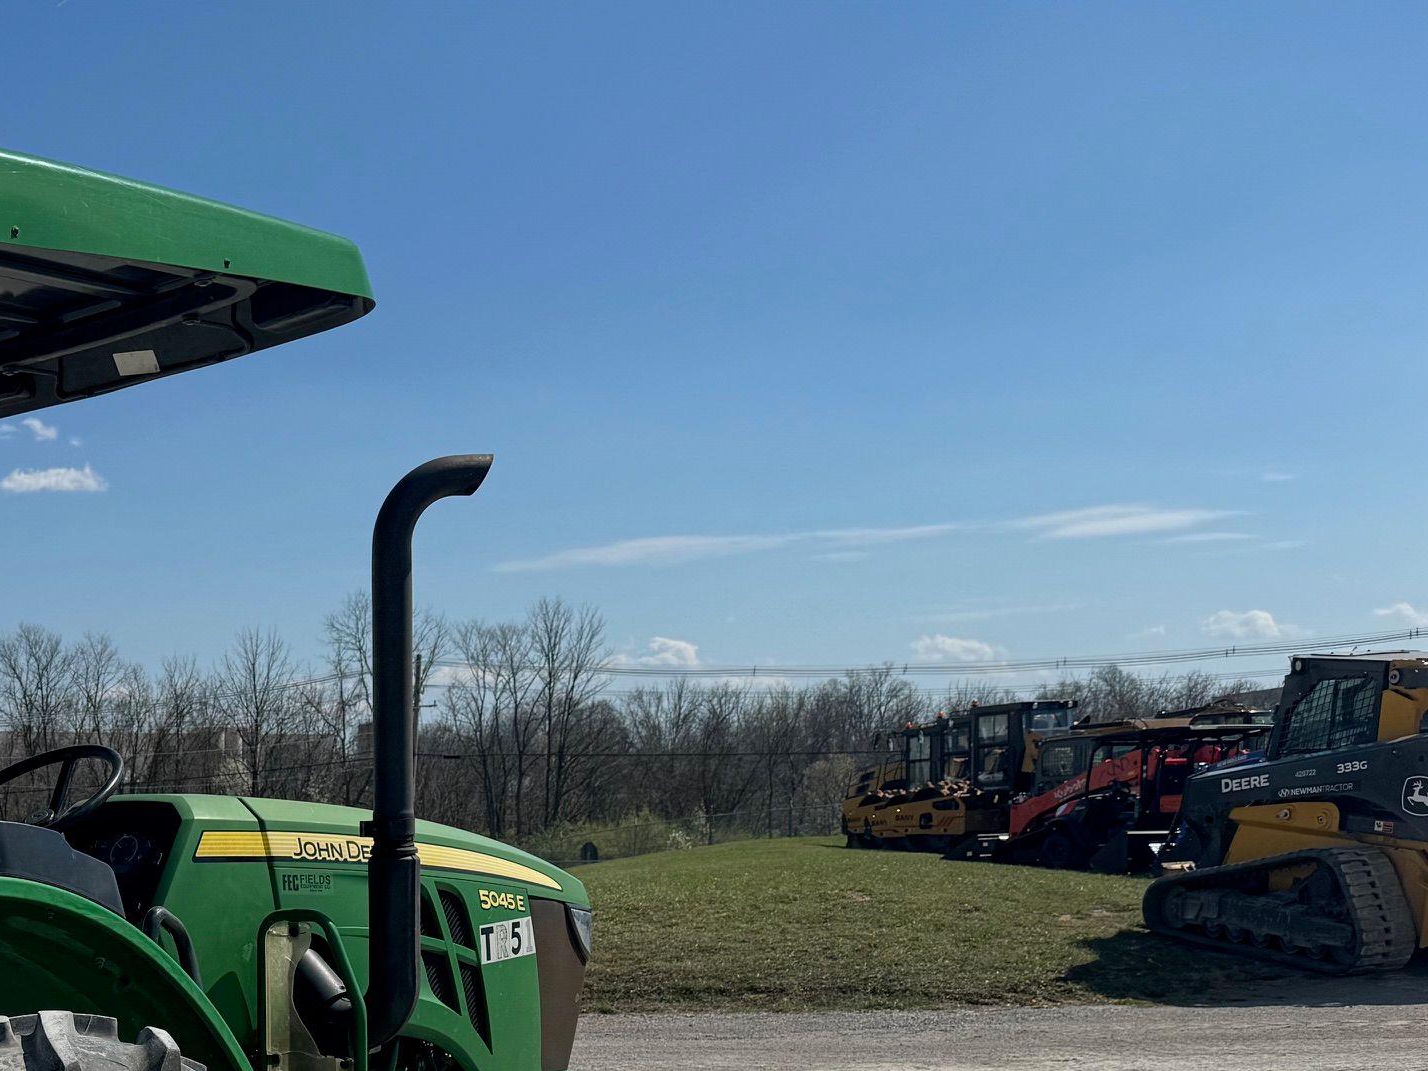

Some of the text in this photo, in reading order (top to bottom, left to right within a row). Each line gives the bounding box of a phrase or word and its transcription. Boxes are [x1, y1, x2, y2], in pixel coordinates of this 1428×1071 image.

[1336, 760, 1368, 774] 333G
[1221, 774, 1270, 793] DEERE
[293, 837, 343, 859] JOHN
[282, 874, 300, 891] FEC
[300, 874, 331, 885] FIELDS
[478, 889, 526, 912] 5045 E
